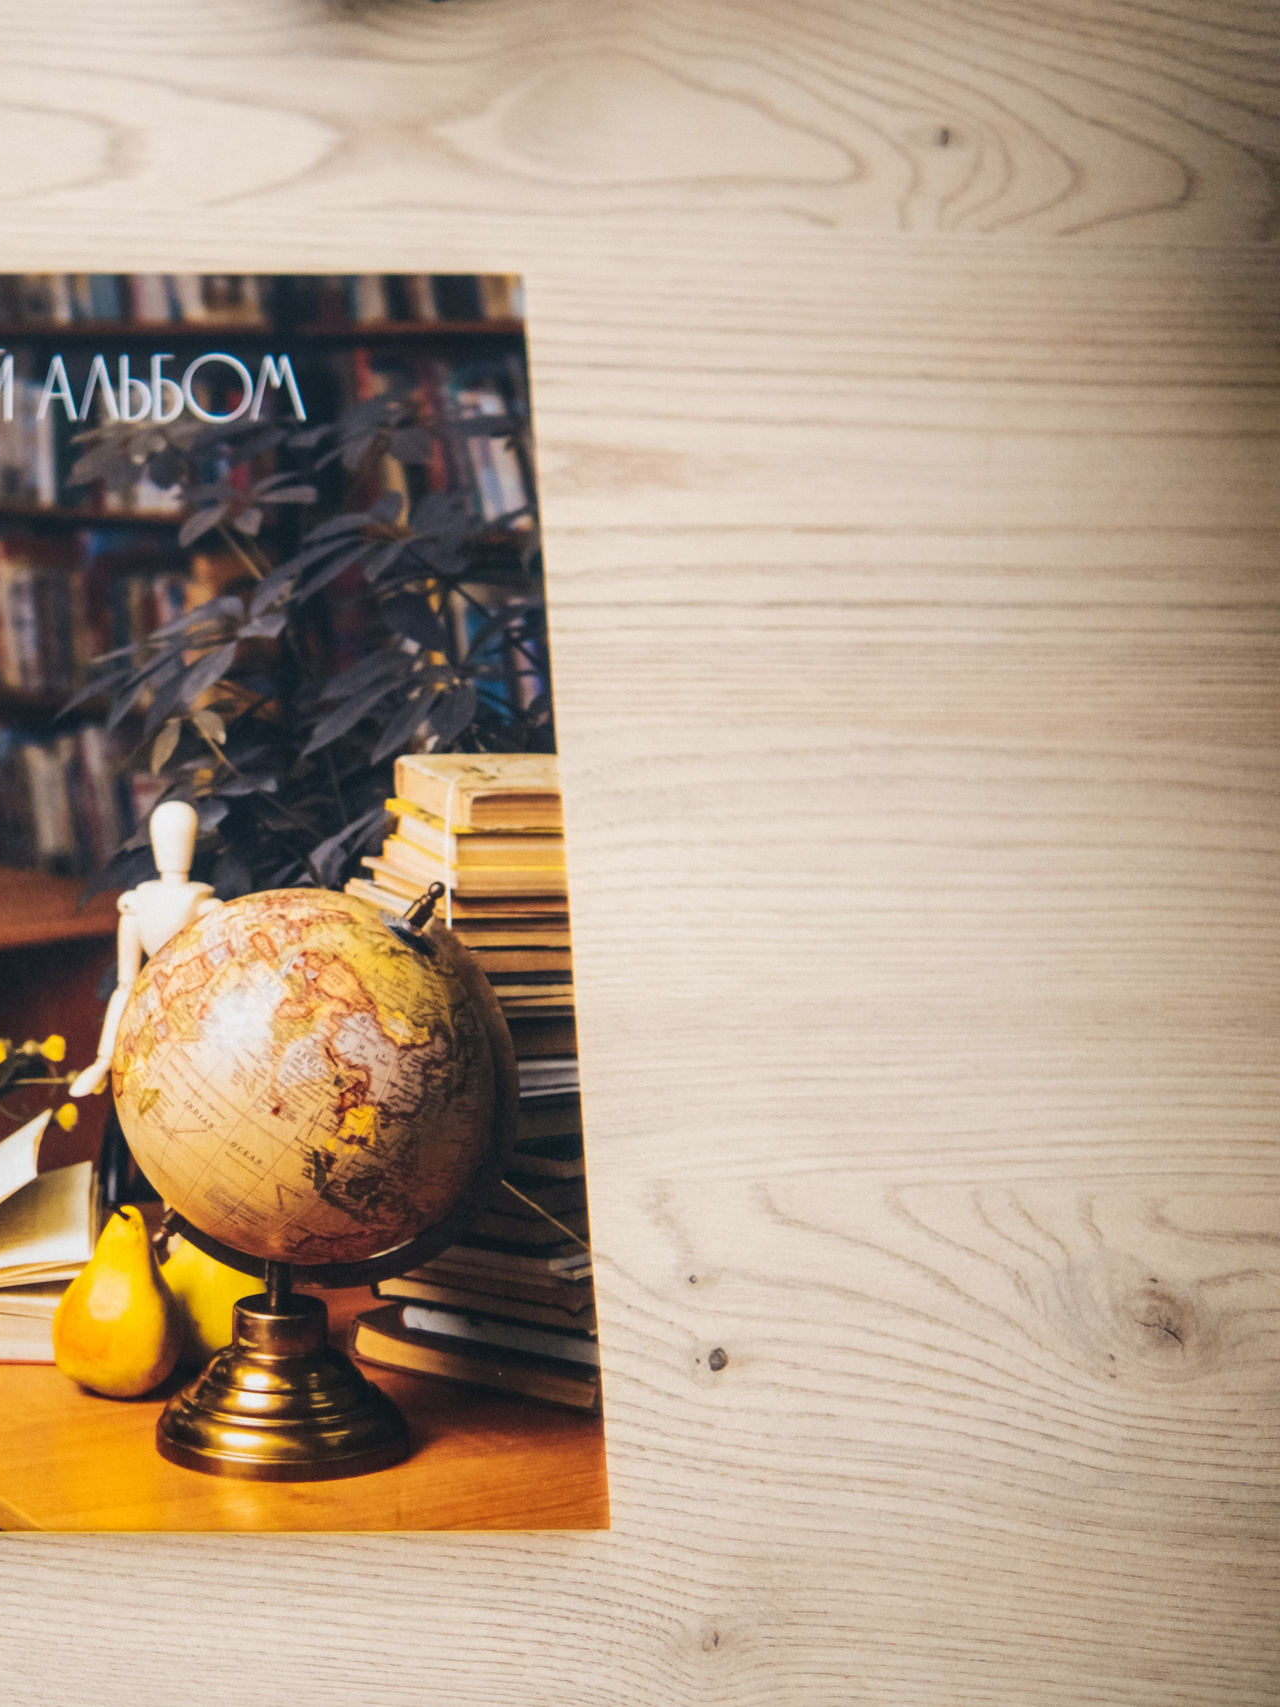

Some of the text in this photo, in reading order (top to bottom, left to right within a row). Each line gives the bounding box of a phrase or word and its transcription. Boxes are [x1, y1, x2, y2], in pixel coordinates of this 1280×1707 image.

[35, 352, 308, 424] АЛЬБОМ
[183, 1099, 215, 1130] INDIAN
[230, 1140, 263, 1166] OCEAN
